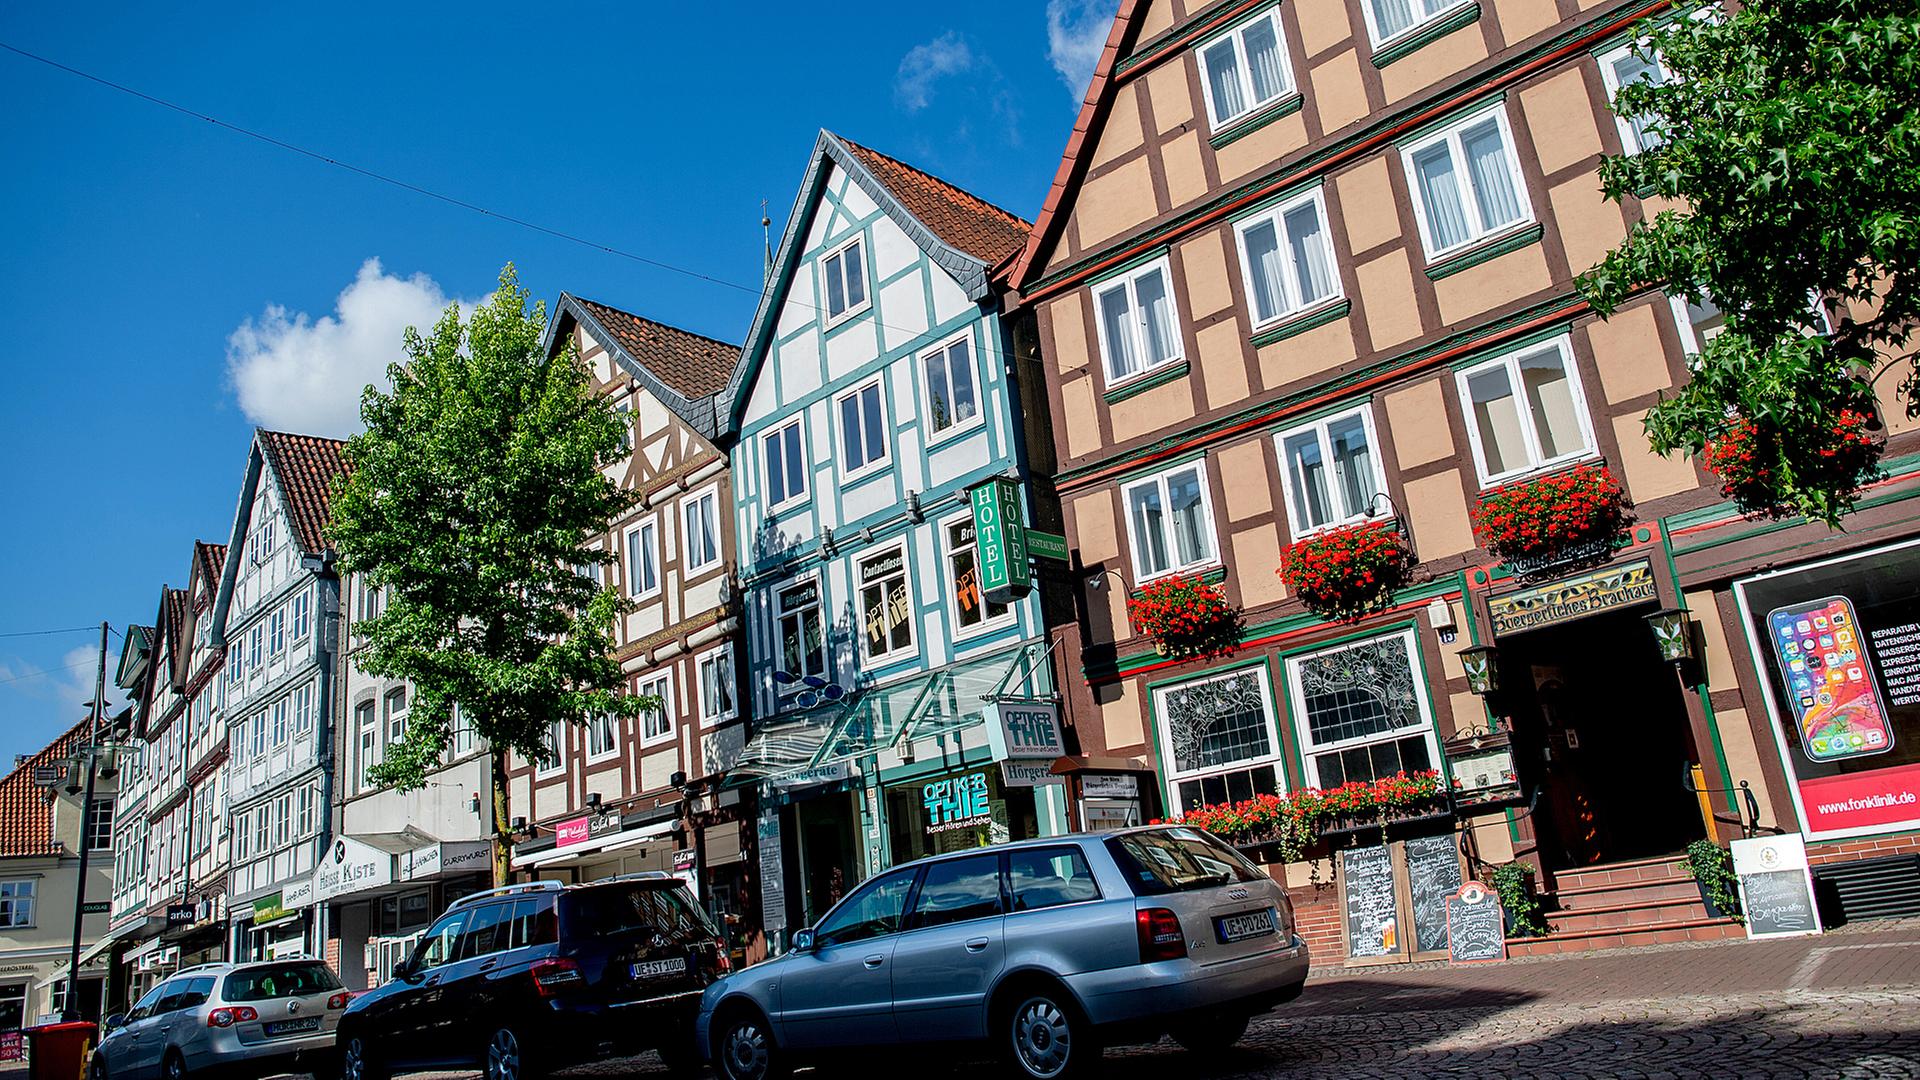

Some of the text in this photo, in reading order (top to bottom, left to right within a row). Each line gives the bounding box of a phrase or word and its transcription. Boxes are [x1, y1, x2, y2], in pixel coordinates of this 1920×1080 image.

[977, 486, 1002, 583] HOTEL
[1003, 485, 1026, 580] HOTEL
[1441, 631, 1456, 644] 15
[1871, 624, 1916, 639] REPARATUR
[1886, 677, 1905, 687] MAC
[1006, 711, 1053, 725] OPTIKER
[1008, 722, 1058, 746] THIE
[923, 772, 988, 801] OPTIKER
[924, 788, 990, 826] THIE
[1817, 791, 1917, 815] www.fonklinik.de
[443, 848, 490, 866] CURRYWURST
[170, 909, 193, 920] arko
[1224, 911, 1272, 936] UE PD 261
[634, 958, 685, 976] UE ST 1000
[1, 1040, 19, 1049] SALE
